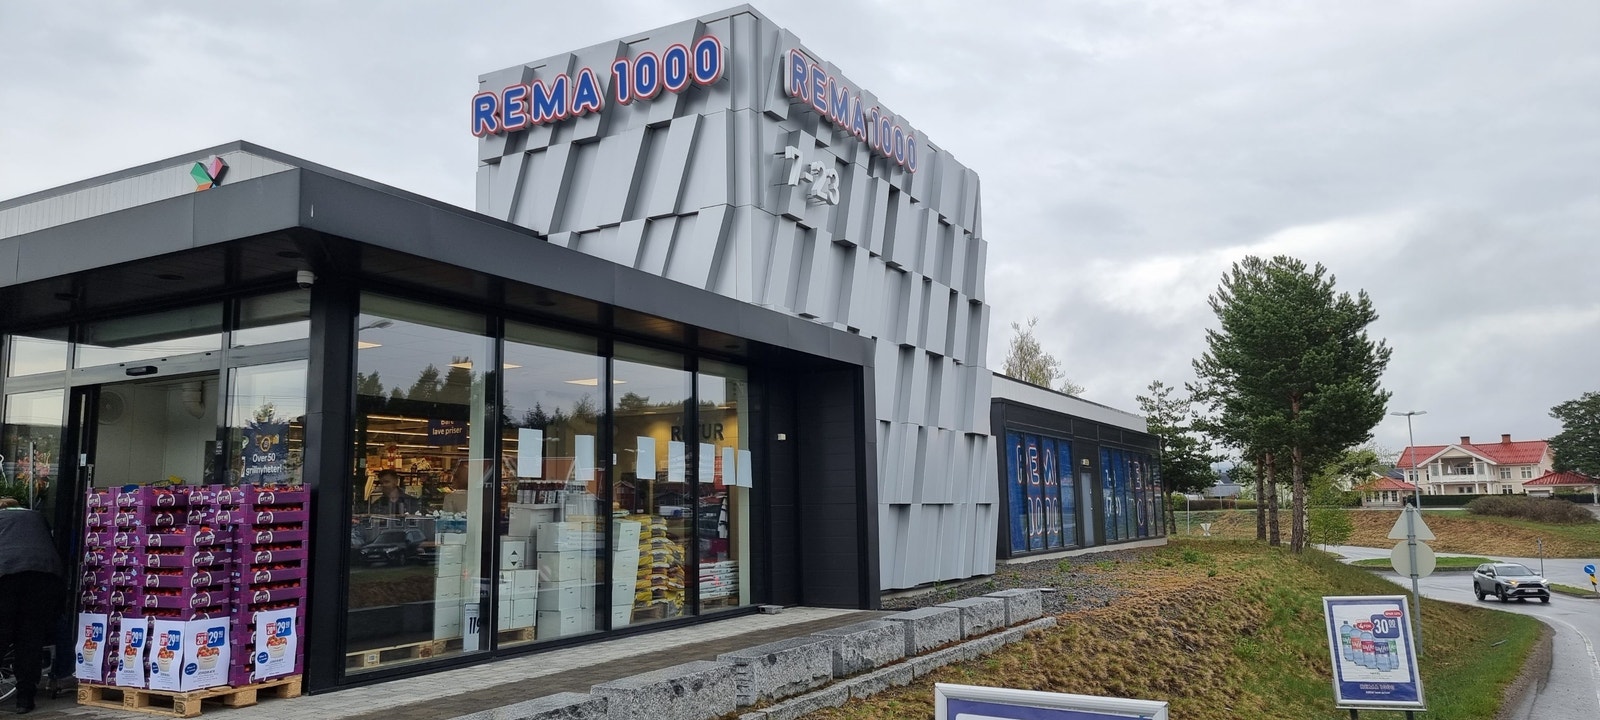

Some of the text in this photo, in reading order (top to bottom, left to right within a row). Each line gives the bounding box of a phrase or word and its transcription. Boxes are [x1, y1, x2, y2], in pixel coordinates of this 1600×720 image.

[472, 34, 724, 138] REMA 1000
[785, 49, 918, 174] REMA 1000
[784, 146, 840, 206] 7-23
[445, 427, 462, 436] priser
[671, 423, 724, 441] RUR
[252, 453, 276, 462] Over 50
[246, 464, 282, 476] grillnyheter!
[277, 622, 285, 633] 29
[1374, 619, 1388, 634] 30
[132, 632, 138, 643] 29
[169, 634, 175, 646] 29
[209, 631, 218, 644] 29
